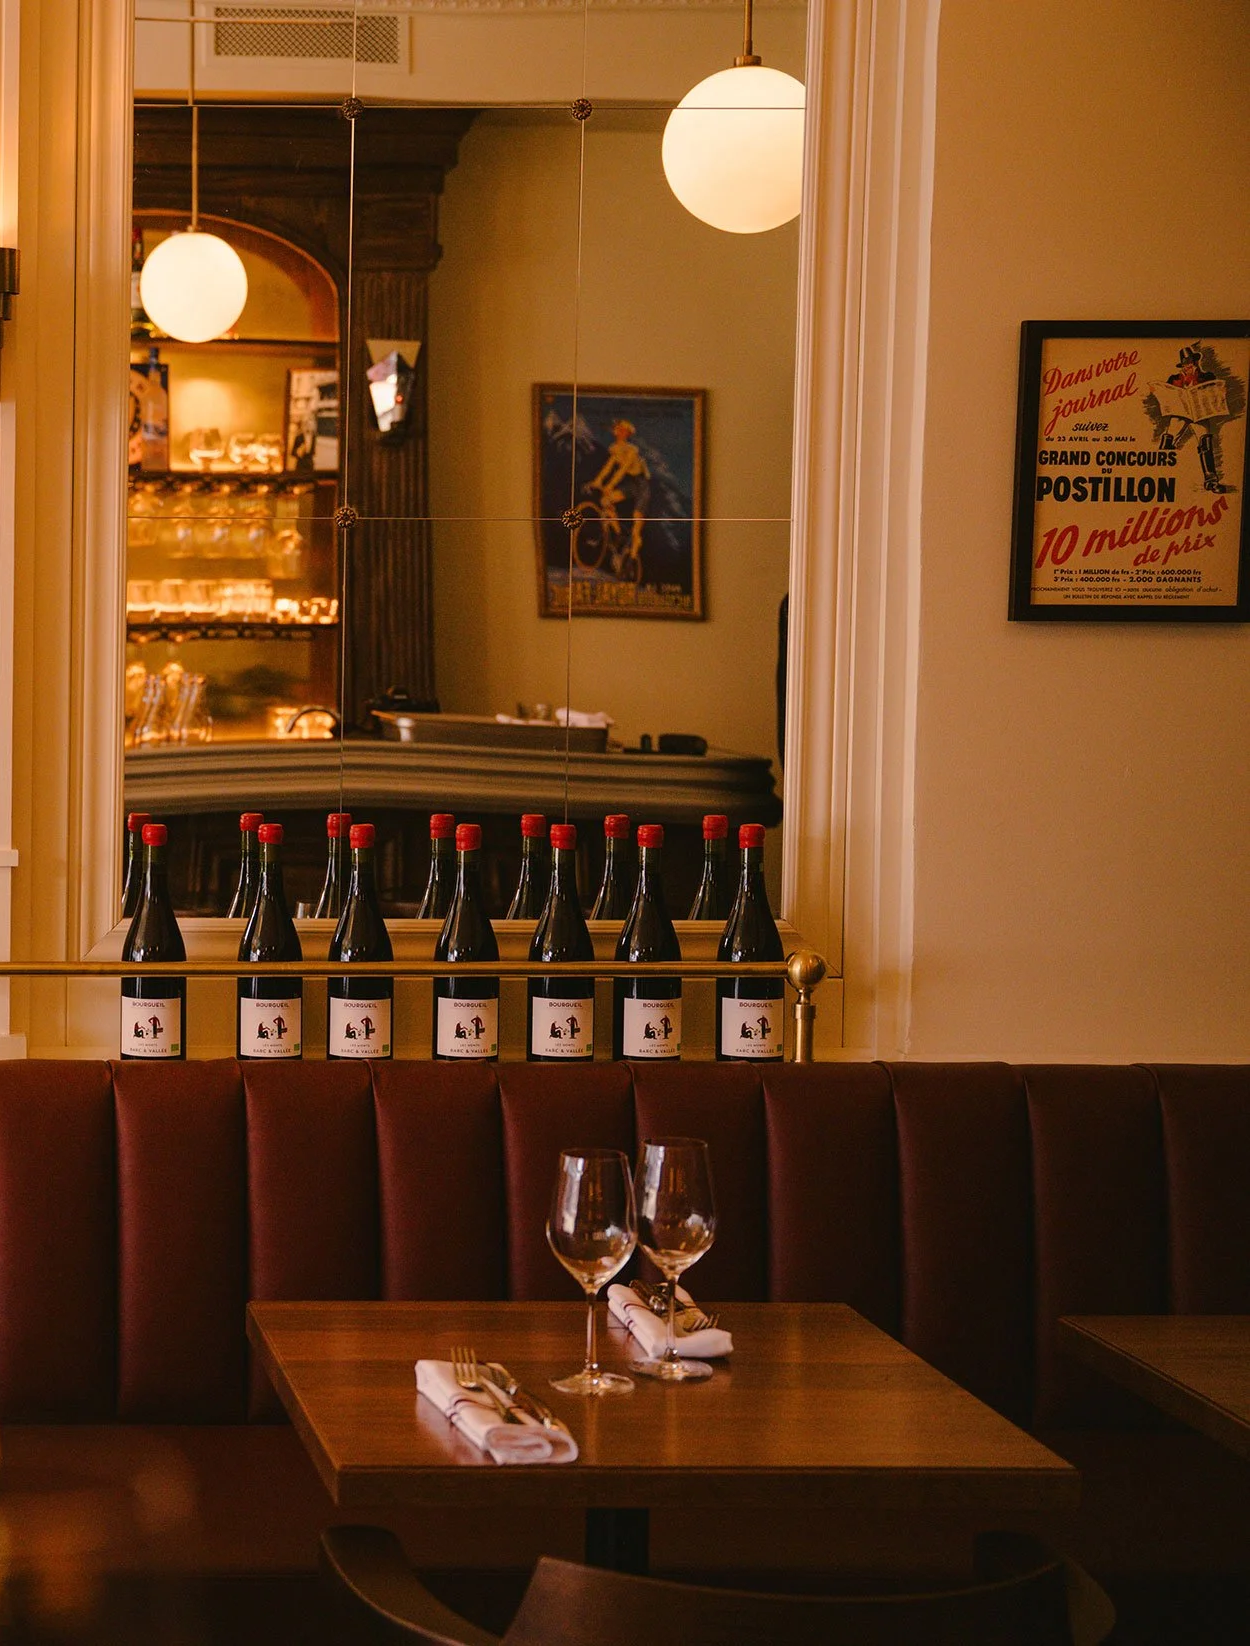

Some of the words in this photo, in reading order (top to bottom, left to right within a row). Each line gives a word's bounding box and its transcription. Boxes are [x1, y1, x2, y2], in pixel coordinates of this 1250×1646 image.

[1043, 364, 1093, 396] Dans
[1095, 350, 1141, 377] votre
[1044, 372, 1138, 436] journal
[1072, 421, 1109, 431] suivez
[1038, 450, 1091, 465] GRAND
[1096, 451, 1177, 466] CONCOURS
[1036, 476, 1176, 502] POSTILLON
[1035, 524, 1079, 569] 10
[1082, 496, 1228, 557] millions
[1133, 545, 1160, 567] de
[1162, 533, 1216, 565] prix
